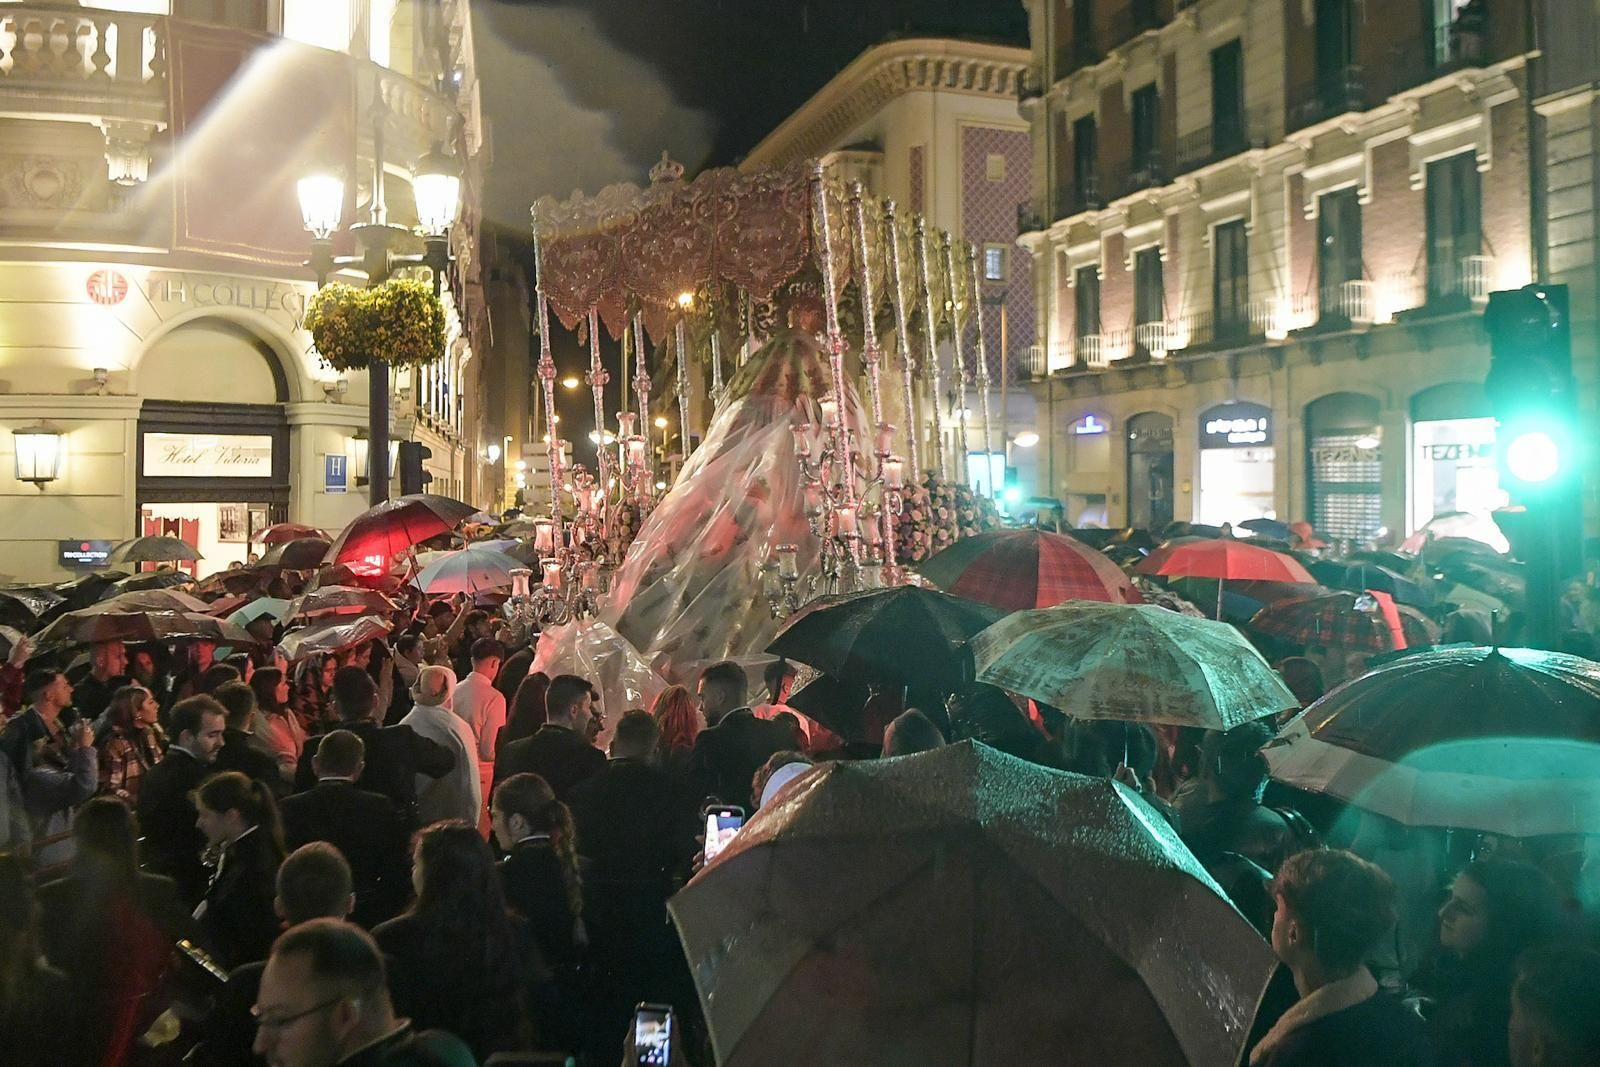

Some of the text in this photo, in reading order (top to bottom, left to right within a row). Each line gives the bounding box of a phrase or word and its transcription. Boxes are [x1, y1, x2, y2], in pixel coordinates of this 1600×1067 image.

[160, 445, 261, 464] Hotel Victoria
[1310, 447, 1377, 464] TEZENIS
[331, 457, 341, 476] H
